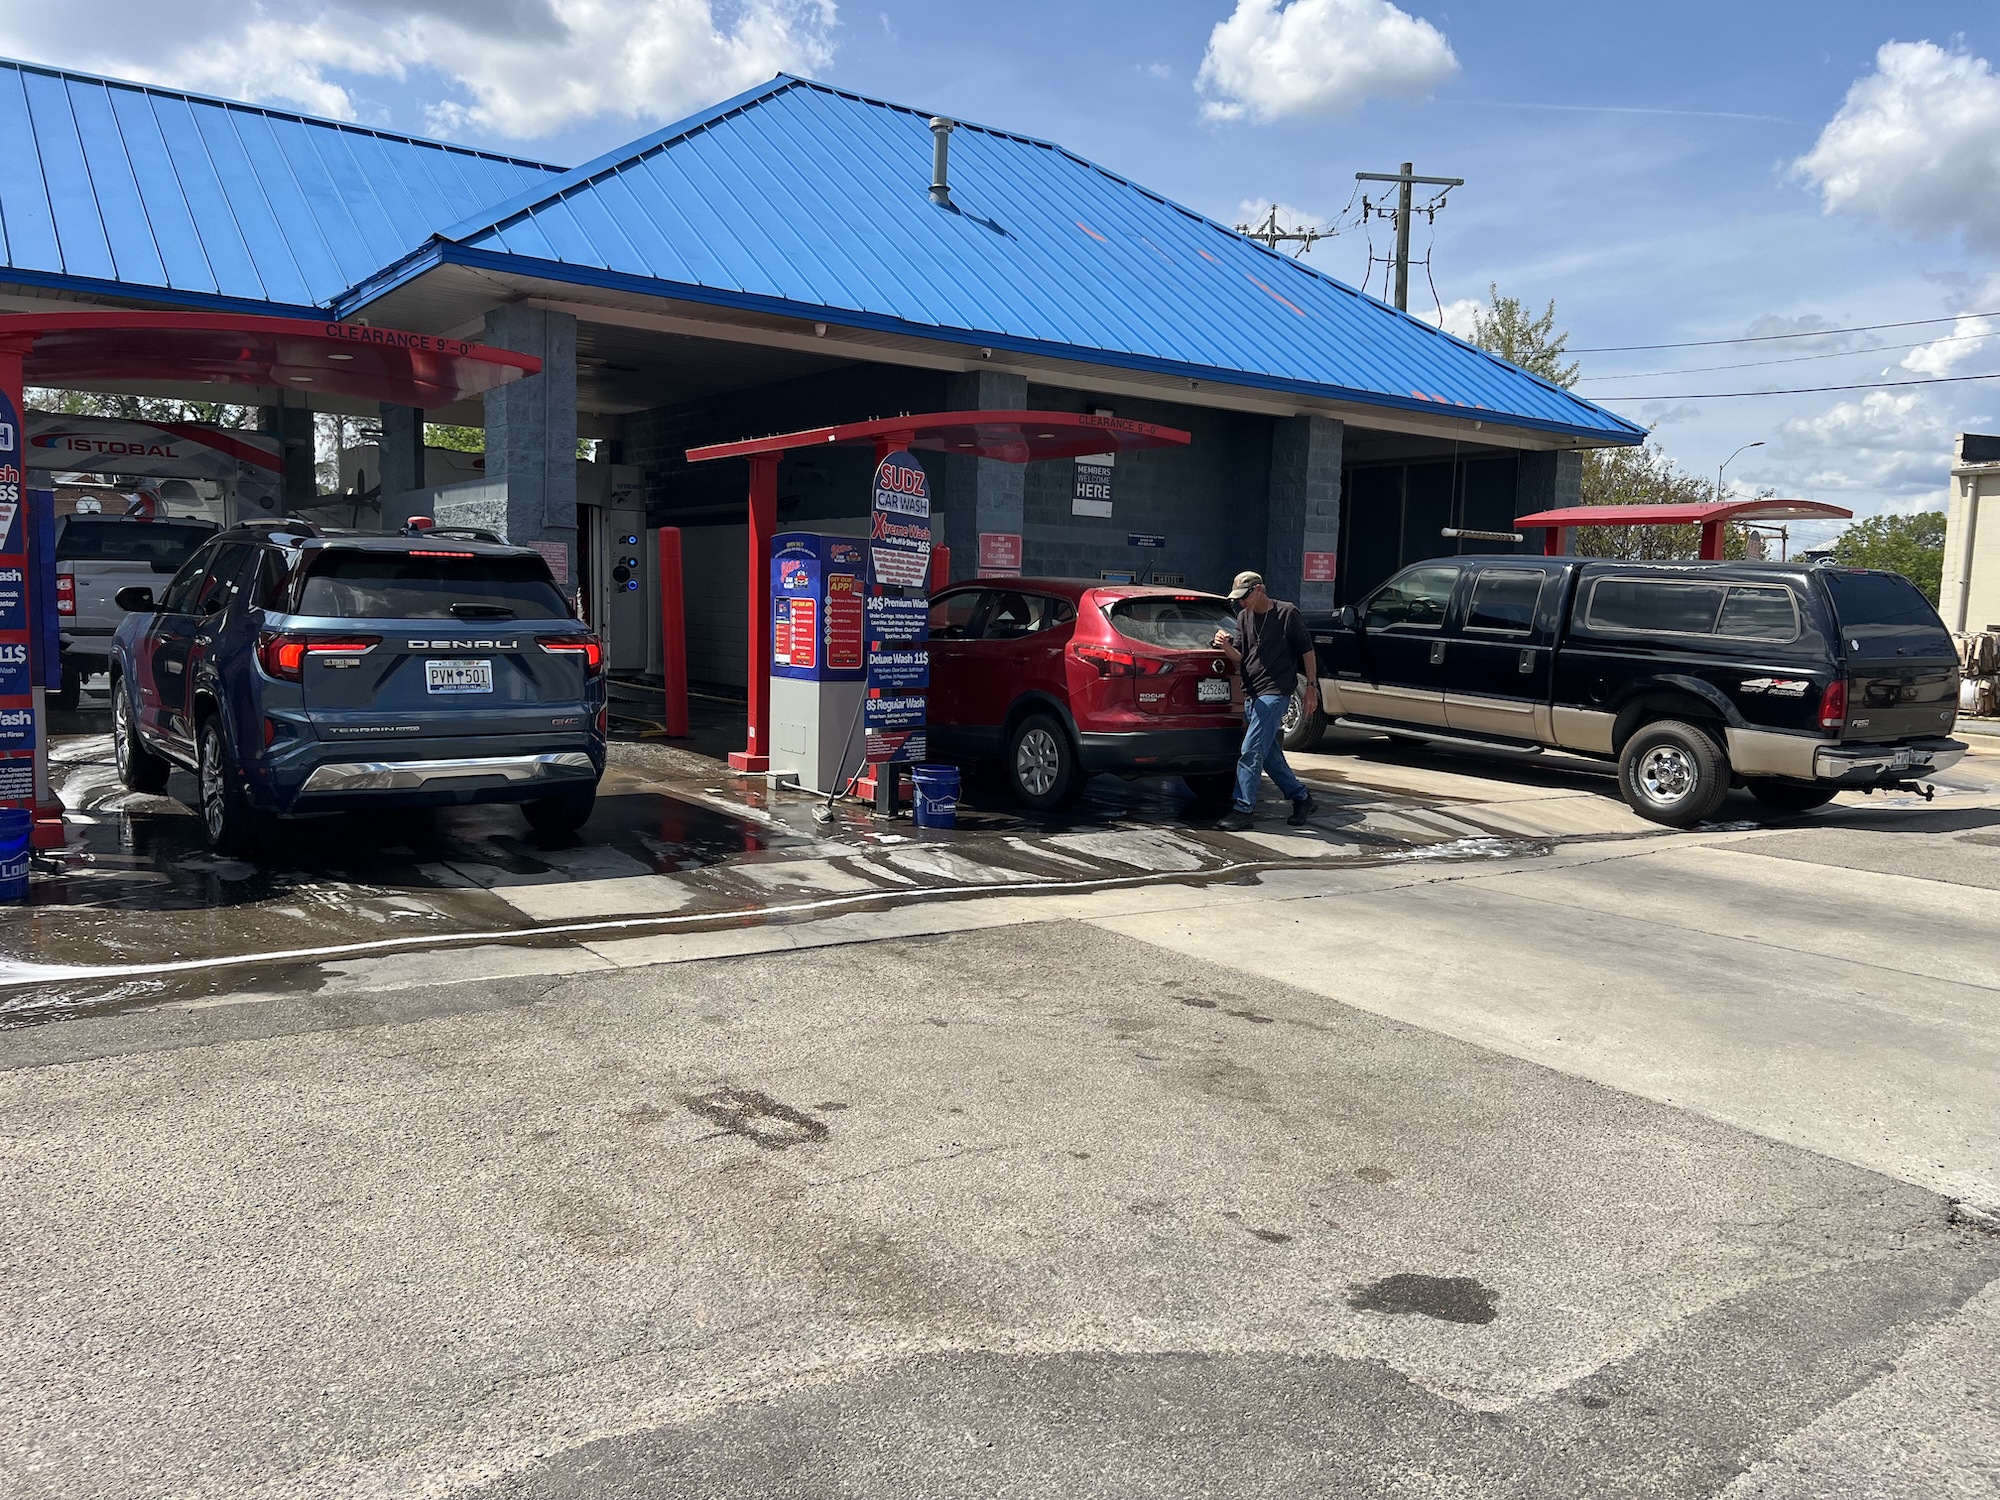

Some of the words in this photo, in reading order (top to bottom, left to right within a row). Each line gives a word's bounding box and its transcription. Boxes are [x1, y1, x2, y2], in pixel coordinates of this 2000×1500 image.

[325, 324, 430, 350] CLEARANCE
[1078, 415, 1134, 431] CLEARANCE
[67, 439, 179, 458] ISTOBAL
[1077, 465, 1111, 476] MEMBERS
[881, 463, 925, 497] SUDZ
[1077, 474, 1111, 485] WELCOME
[1076, 483, 1111, 499] HERE
[878, 492, 899, 509] CAR
[900, 495, 927, 516] WASH
[871, 511, 909, 541] Xtreme
[909, 524, 932, 541] Wash
[917, 541, 931, 554] 16$
[830, 582, 852, 592] APP!
[867, 596, 884, 611] 14$
[884, 597, 912, 608] Premium
[912, 598, 929, 609] Wash
[407, 640, 519, 649] DENALI
[869, 653, 893, 665] Deluxe
[893, 653, 913, 664] Wash
[914, 652, 929, 665] 11$
[431, 669, 454, 684] PVM
[465, 669, 487, 684] 501
[866, 698, 877, 712] 8$
[877, 698, 906, 712] Regular
[906, 697, 925, 709] Wash
[552, 717, 579, 726] GMC
